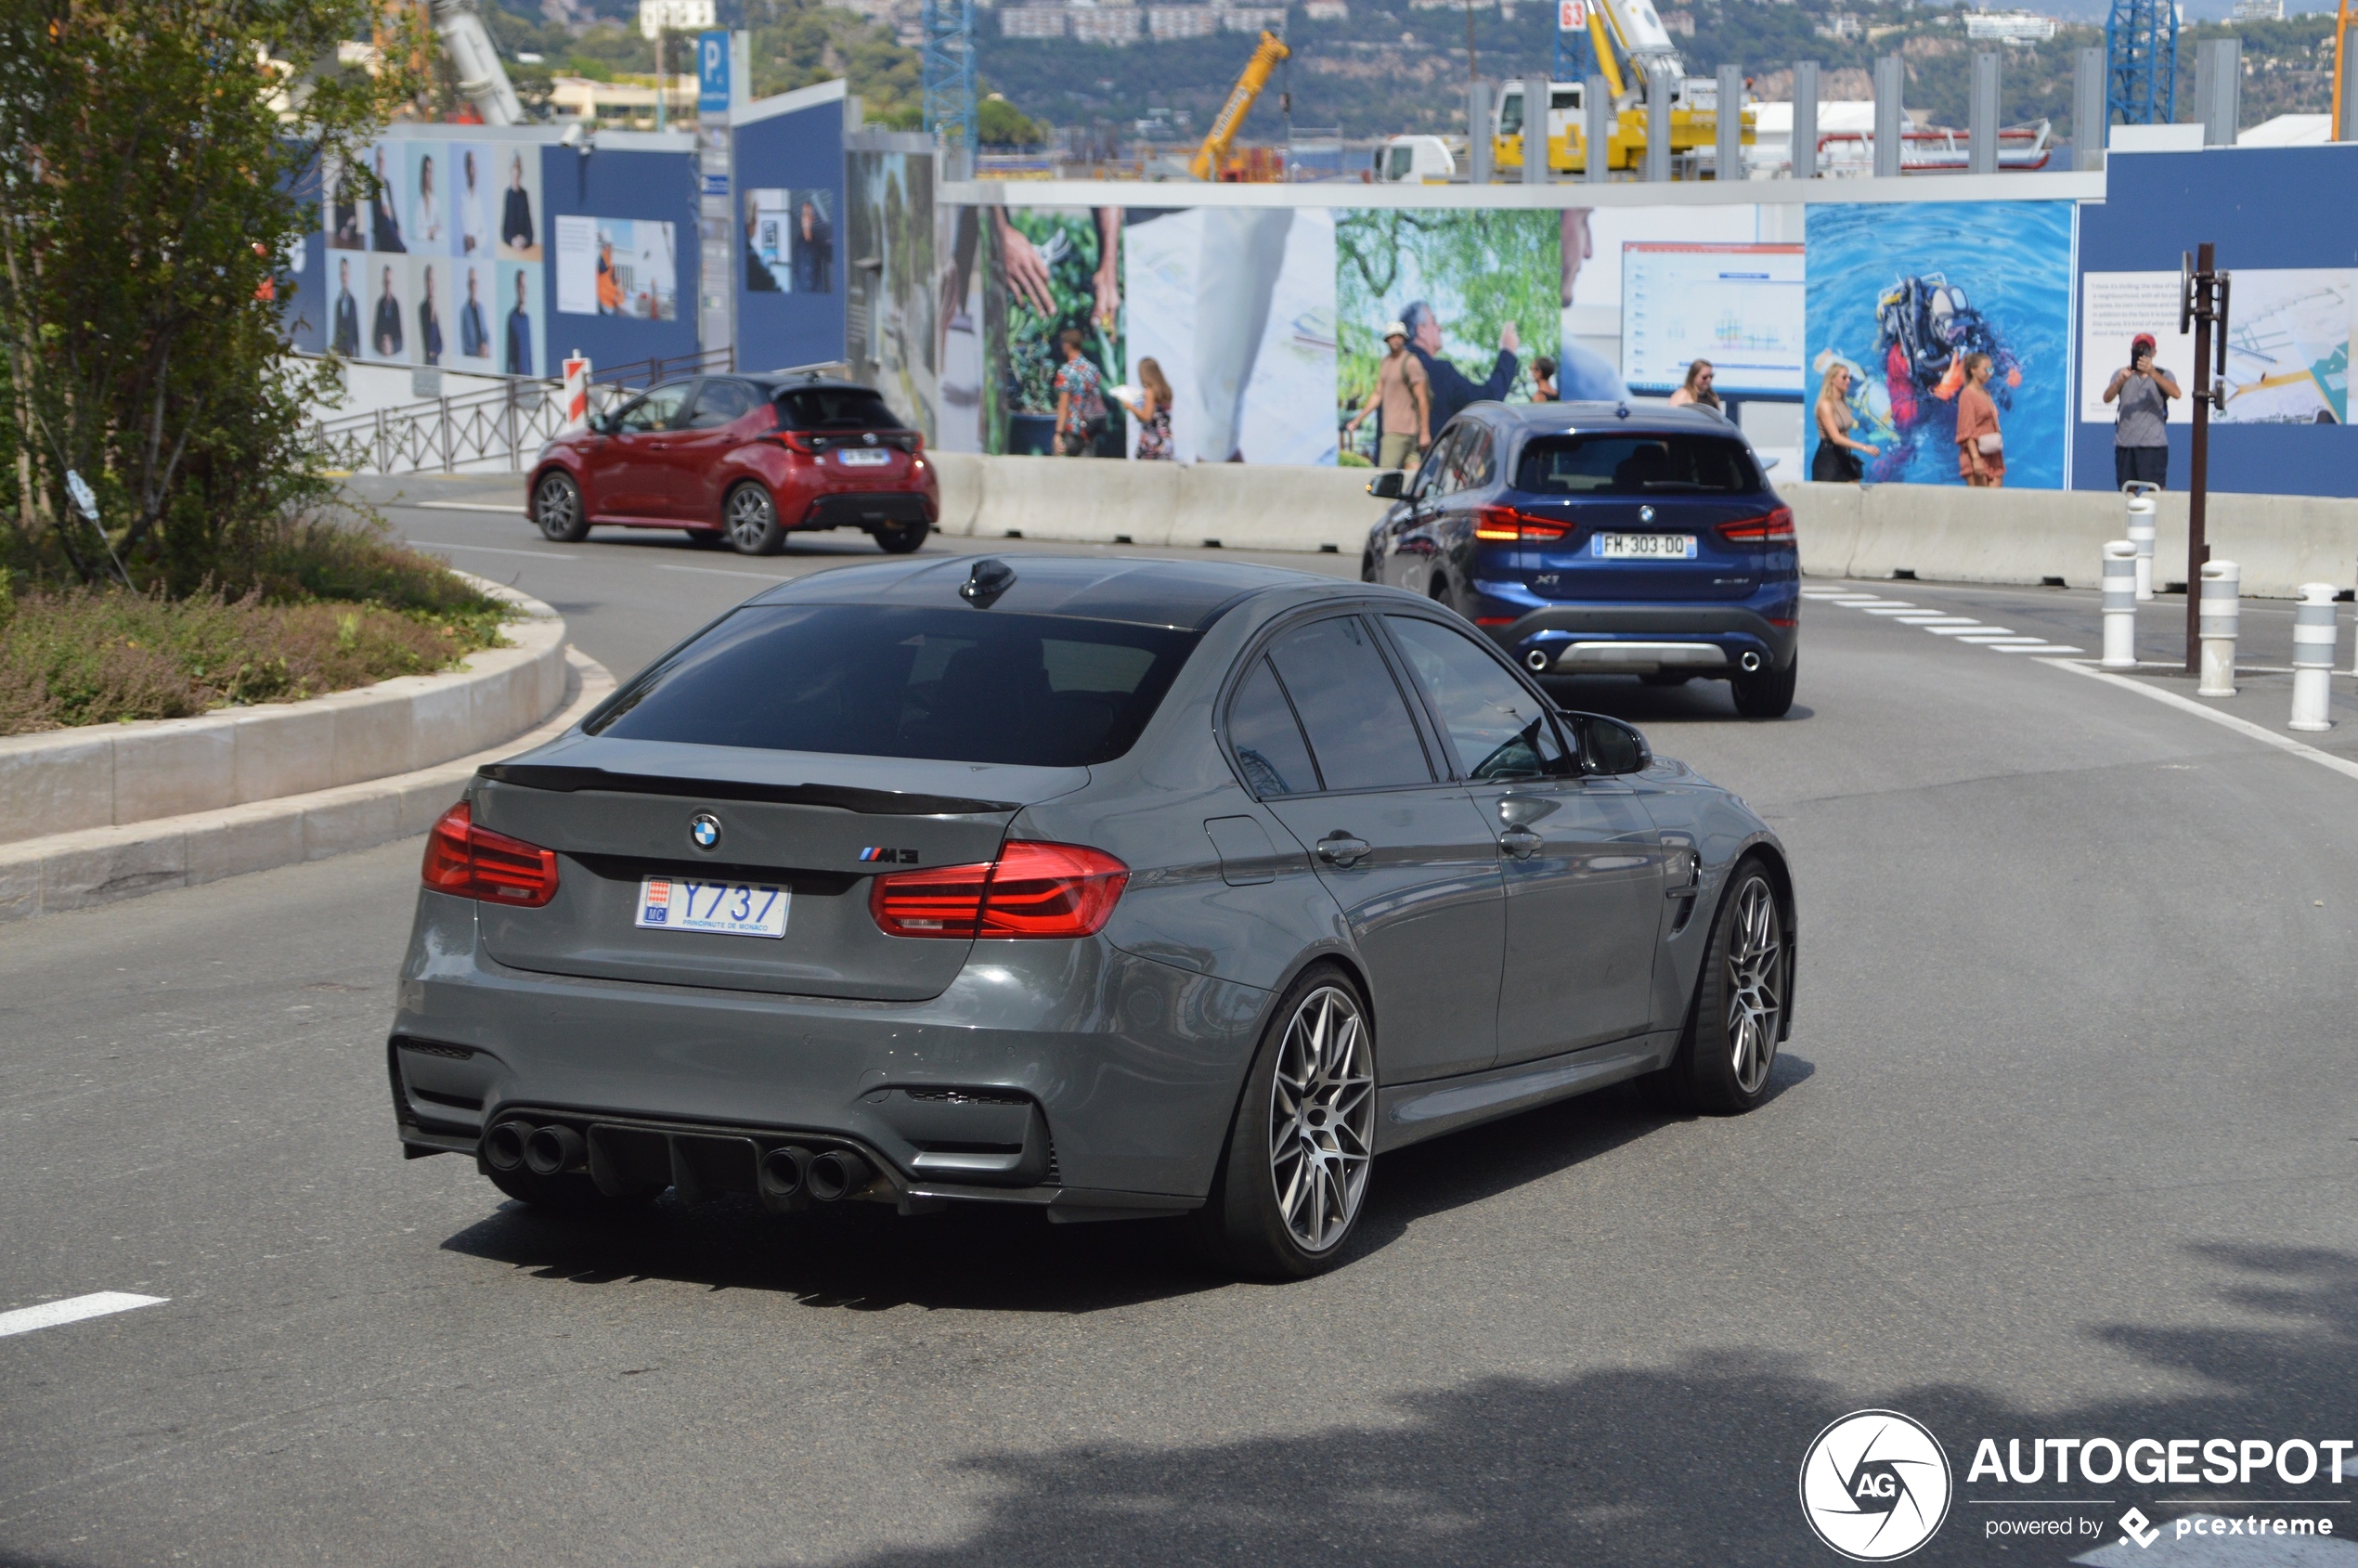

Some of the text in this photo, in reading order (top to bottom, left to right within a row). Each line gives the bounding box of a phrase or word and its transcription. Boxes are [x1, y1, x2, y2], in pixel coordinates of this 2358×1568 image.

[705, 40, 721, 83] P
[875, 848, 919, 864] M3
[648, 908, 664, 921] MC
[683, 880, 780, 923] Y737
